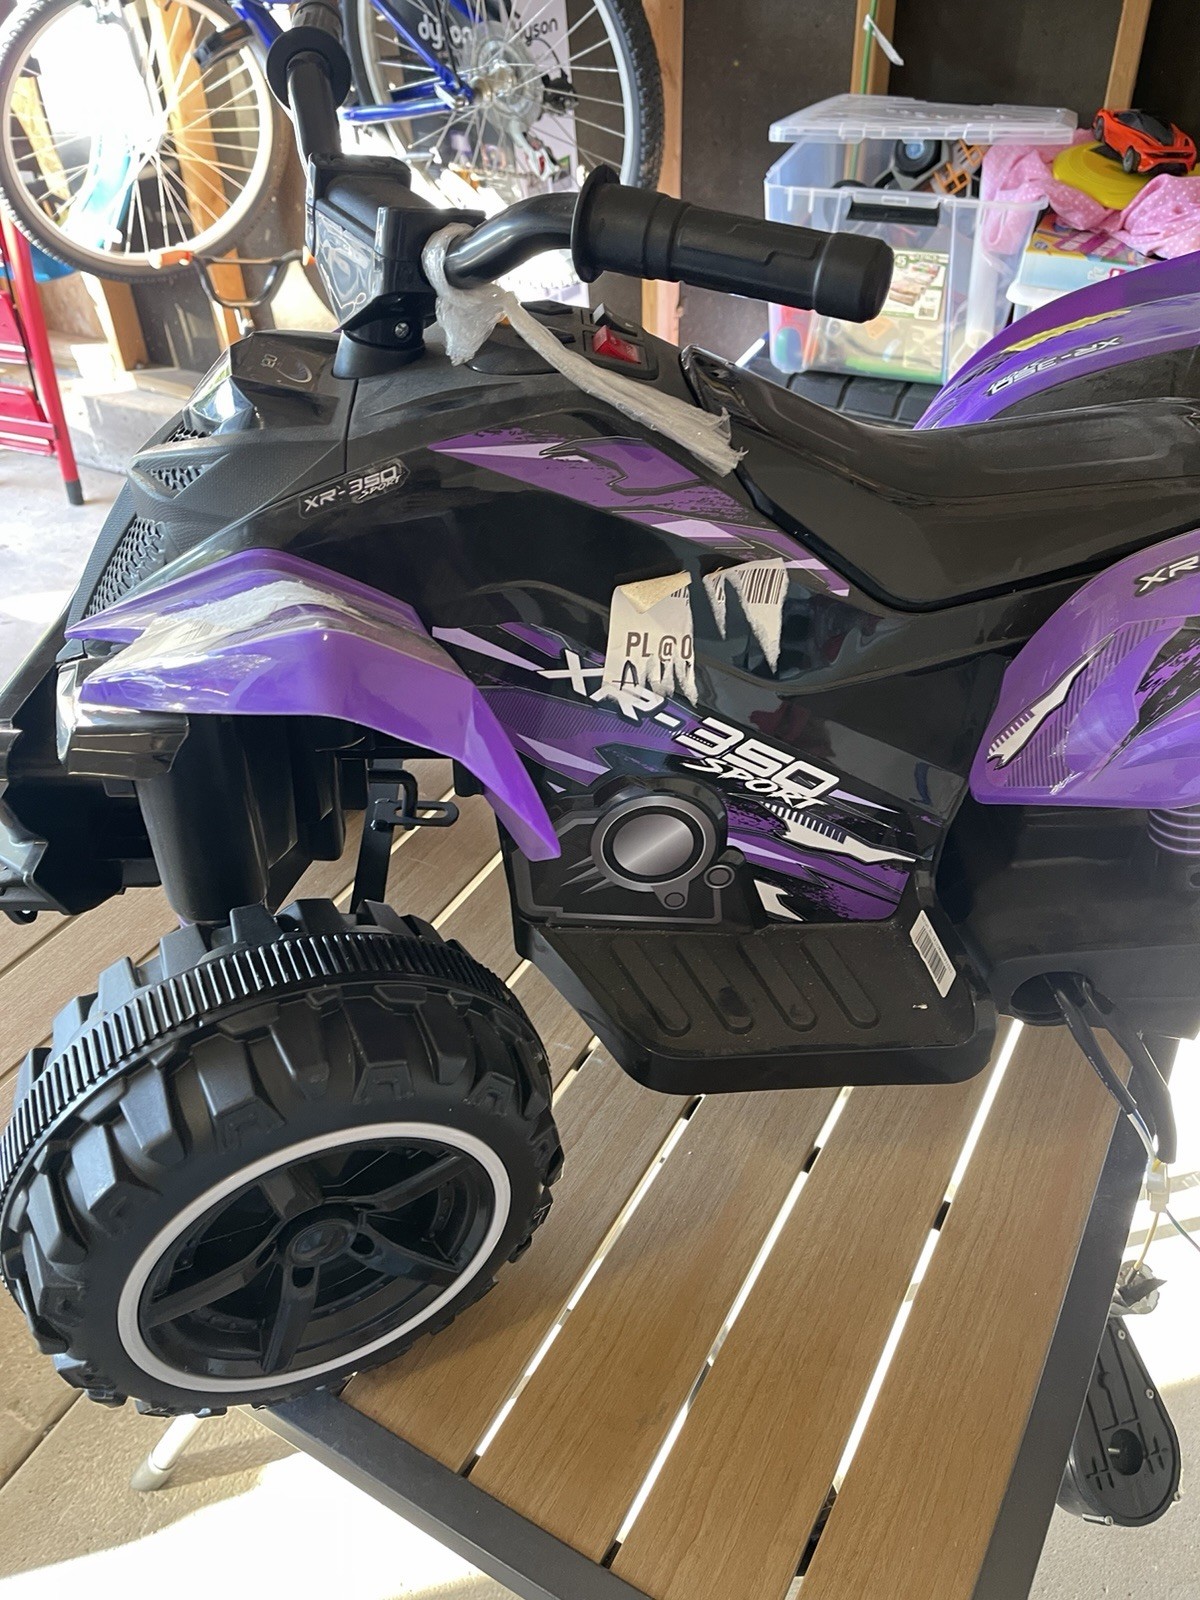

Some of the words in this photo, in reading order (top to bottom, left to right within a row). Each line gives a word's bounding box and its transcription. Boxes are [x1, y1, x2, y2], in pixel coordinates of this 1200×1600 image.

[417, 13, 473, 50] dyon
[304, 466, 397, 512] XR-350
[358, 475, 401, 500] SPORT
[537, 649, 839, 798] XR-350
[681, 758, 828, 809] SPORT
